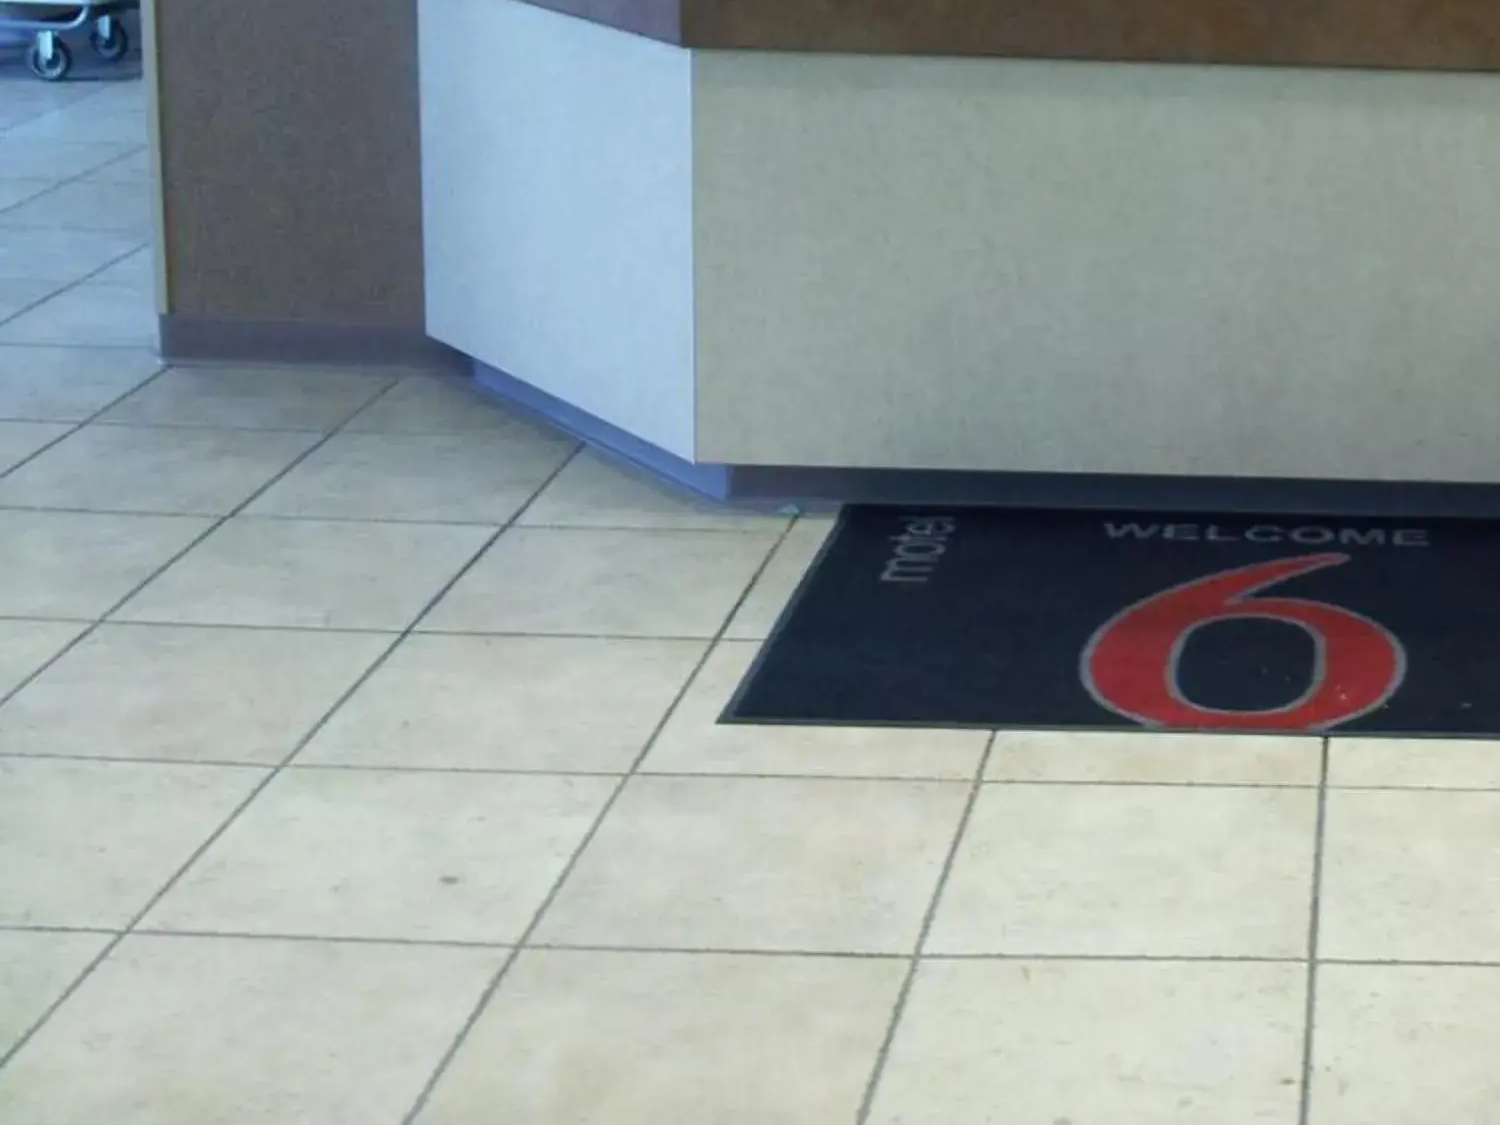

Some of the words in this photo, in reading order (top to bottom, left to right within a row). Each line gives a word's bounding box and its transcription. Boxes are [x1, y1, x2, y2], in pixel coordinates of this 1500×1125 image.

[881, 516, 956, 581] motel
[1102, 522, 1430, 547] WELCOME
[1079, 552, 1407, 731] 6
